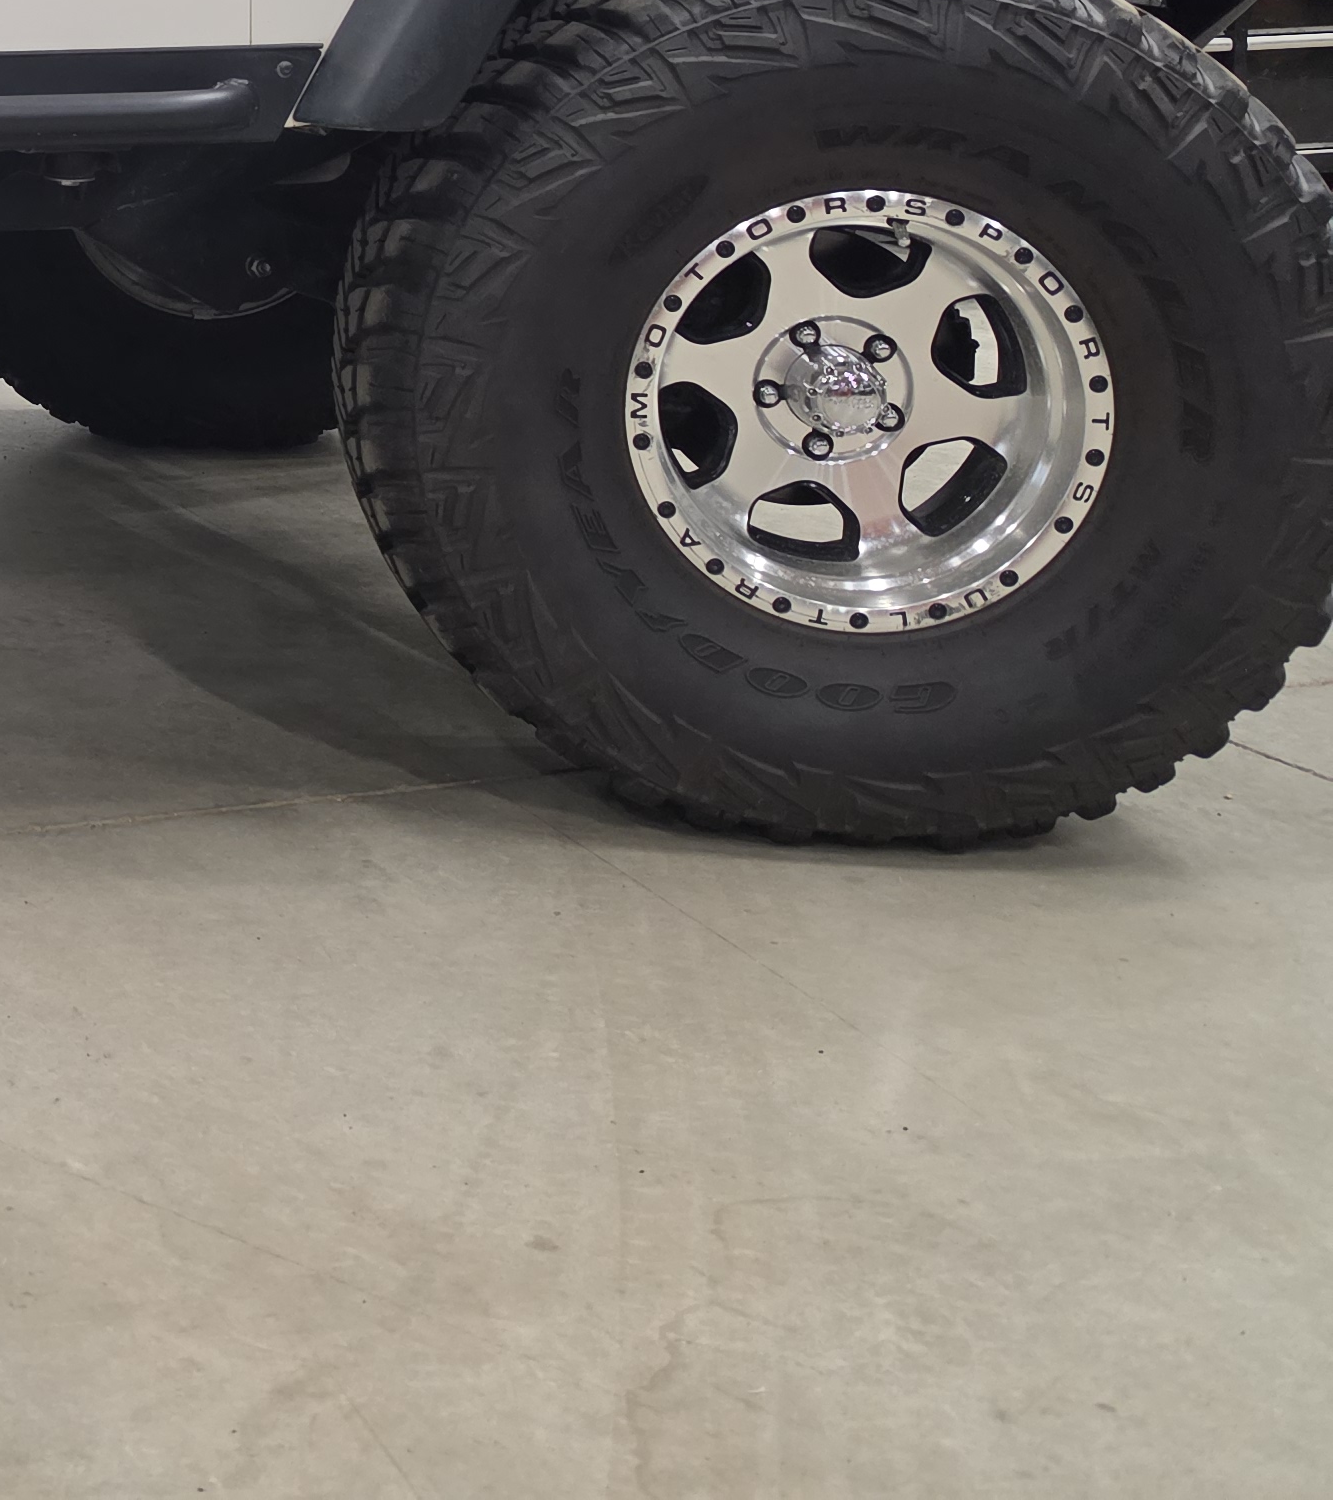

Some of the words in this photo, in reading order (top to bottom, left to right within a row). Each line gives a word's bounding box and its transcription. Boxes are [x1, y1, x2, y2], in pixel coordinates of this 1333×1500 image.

[629, 195, 1113, 504] MOTORSPORTS
[554, 367, 959, 714] GOODYEAR
[678, 526, 989, 628] ULTRA
